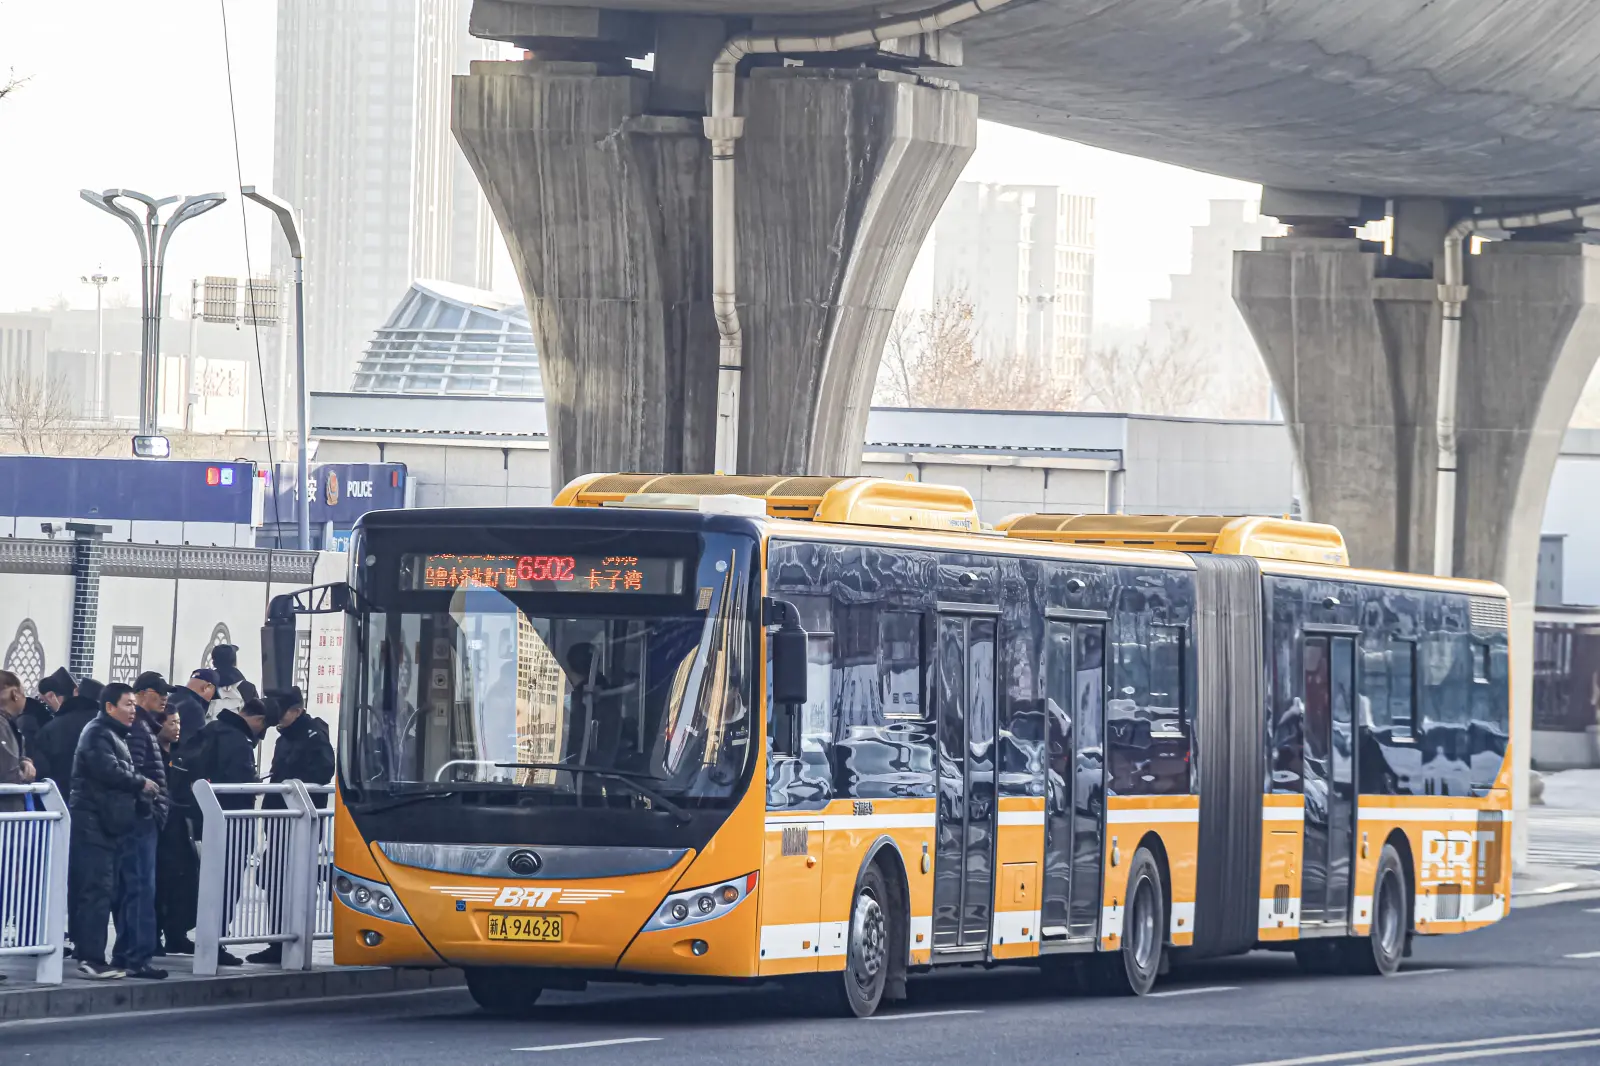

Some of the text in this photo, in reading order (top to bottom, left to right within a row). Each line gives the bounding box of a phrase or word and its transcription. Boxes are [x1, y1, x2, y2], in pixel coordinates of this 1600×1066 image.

[347, 481, 373, 497] POLICE
[517, 555, 575, 581] 6502
[584, 568, 643, 590] 卡子湾
[1420, 830, 1495, 886] BRT
[494, 887, 562, 908] BRT
